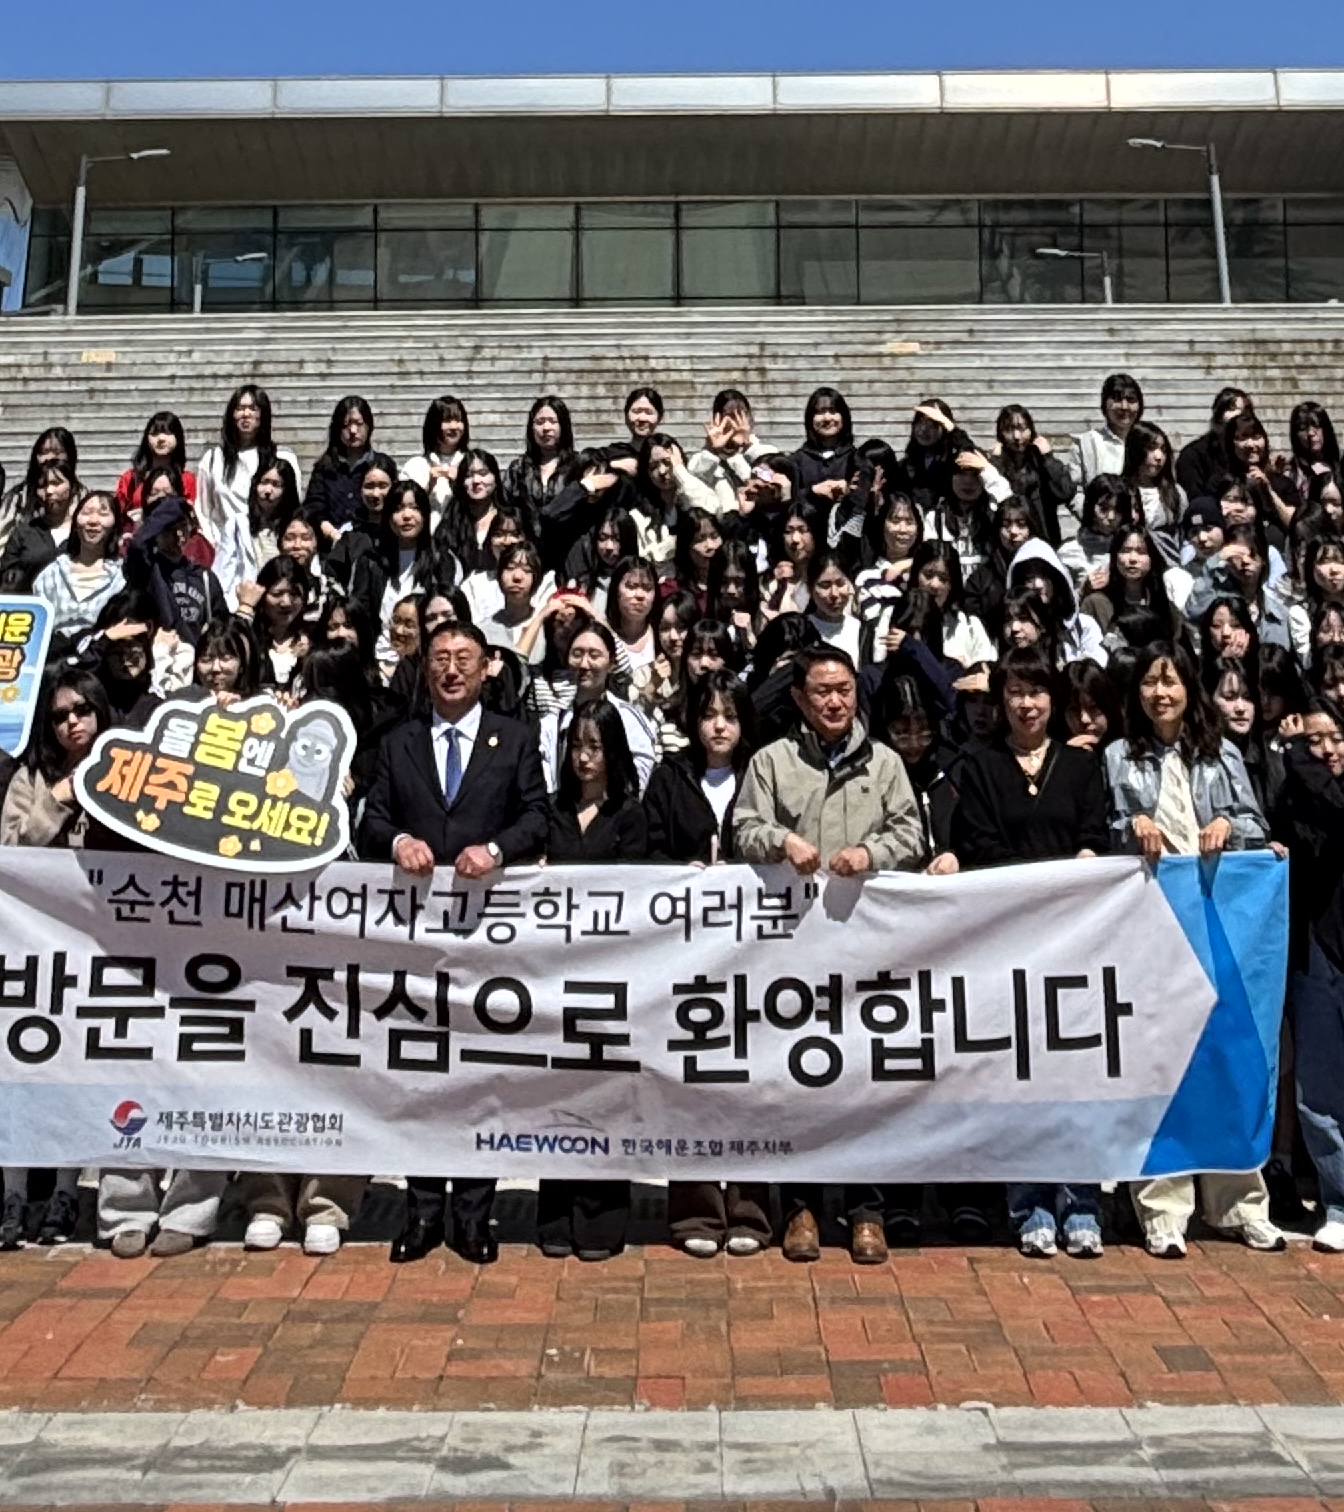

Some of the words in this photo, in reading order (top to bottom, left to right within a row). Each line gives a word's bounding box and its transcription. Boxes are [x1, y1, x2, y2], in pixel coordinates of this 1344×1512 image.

[96, 746, 222, 821] 제주로
[220, 789, 331, 847] 오세요!
[223, 878, 631, 945] 매산여자고등학교
[282, 962, 643, 1075] 진심으로
[666, 965, 1136, 1089] 환영합니다
[156, 1109, 344, 1134] 제주특별자치도관광협회
[475, 1132, 610, 1156] HAEWOON
[620, 1137, 723, 1157] 한국해운조합
[728, 1138, 794, 1156] 제주지부
